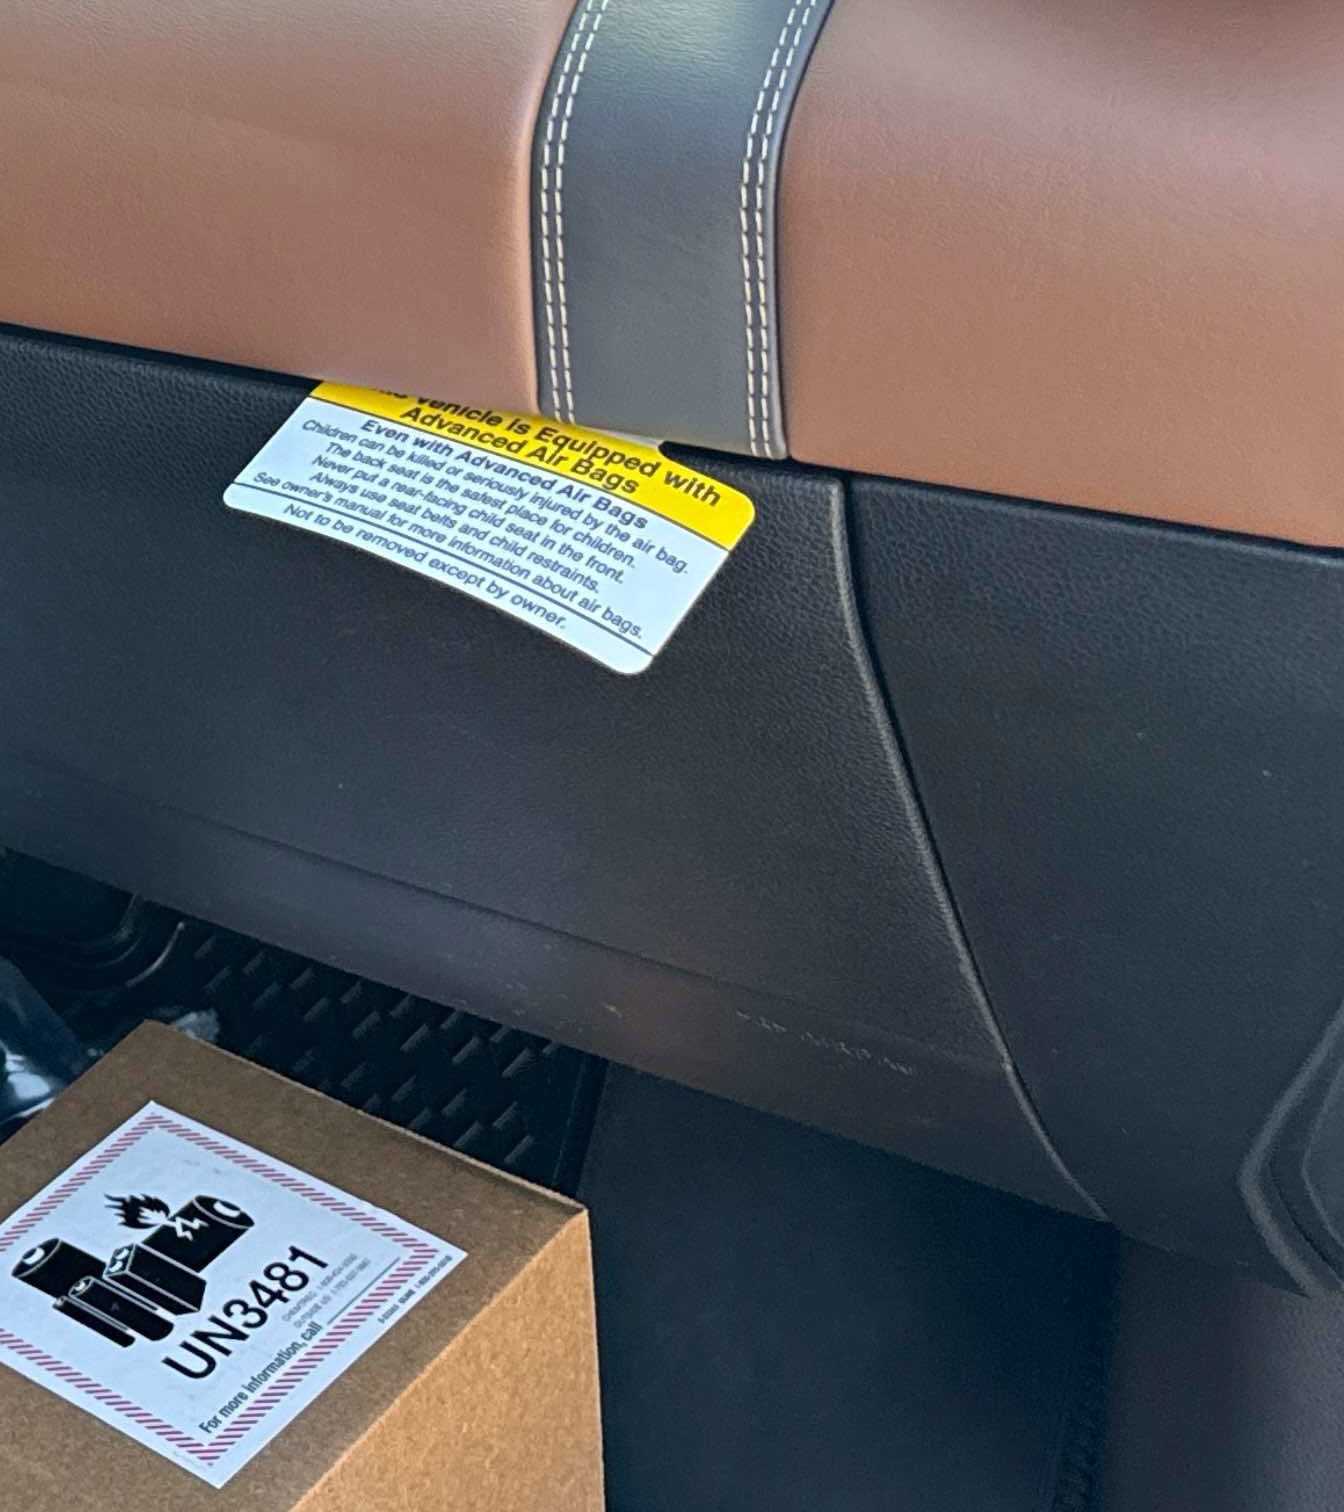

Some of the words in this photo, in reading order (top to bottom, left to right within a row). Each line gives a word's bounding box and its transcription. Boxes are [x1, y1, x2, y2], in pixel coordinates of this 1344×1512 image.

[302, 419, 358, 444] Children
[358, 437, 385, 452] can
[386, 443, 404, 458] be
[406, 451, 444, 471] killed
[446, 465, 464, 477] or
[463, 469, 530, 500] seriously
[530, 492, 583, 520] injured
[582, 512, 604, 530] by
[604, 524, 631, 542] the
[632, 536, 656, 552] air
[655, 549, 688, 574] bag.
[326, 442, 351, 457] The
[353, 450, 386, 468] back
[389, 463, 421, 479] seat
[420, 471, 435, 484] is
[435, 476, 459, 492] the
[461, 488, 506, 512] safest
[505, 504, 548, 527] place
[550, 519, 574, 535] for
[573, 530, 635, 569] children.
[360, 419, 410, 443] Even
[413, 437, 453, 457] with
[455, 449, 557, 491] Advanced
[557, 483, 592, 503] Air
[593, 496, 648, 529] Bags
[400, 407, 527, 454] Advanced
[527, 446, 572, 468] Air
[570, 459, 640, 494] Bags
[535, 426, 661, 478] Equipped
[664, 470, 722, 508] with
[253, 471, 281, 487] See
[281, 480, 333, 503] owner's
[334, 497, 389, 520] manual
[387, 513, 410, 528] for
[409, 523, 448, 543] more
[447, 533, 531, 580] information
[532, 574, 579, 603] about
[578, 597, 602, 614] air
[601, 605, 643, 639] bags.
[283, 503, 312, 521] Not
[314, 513, 331, 526] to
[332, 520, 354, 534] be
[355, 530, 428, 563] removed
[428, 558, 489, 589] except
[486, 580, 511, 600] by
[510, 594, 566, 629] owner.
[309, 471, 360, 494] Always
[360, 489, 388, 503] use
[388, 497, 422, 515] seat
[420, 508, 457, 529] belts
[458, 523, 490, 541] and
[489, 535, 528, 557] child
[527, 551, 600, 594] restraints.
[311, 455, 354, 477] Never
[353, 469, 379, 484] put
[381, 477, 391, 488] a
[391, 480, 468, 516] rear-facing
[468, 508, 504, 528] child
[505, 522, 540, 543] seat
[540, 534, 557, 551] in
[558, 543, 584, 562] the
[585, 557, 625, 584] front.
[162, 1244, 330, 1379] UN3481
[198, 1415, 222, 1434] For
[219, 1391, 249, 1418] more
[241, 1341, 308, 1393] information,
[301, 1321, 323, 1341] call
